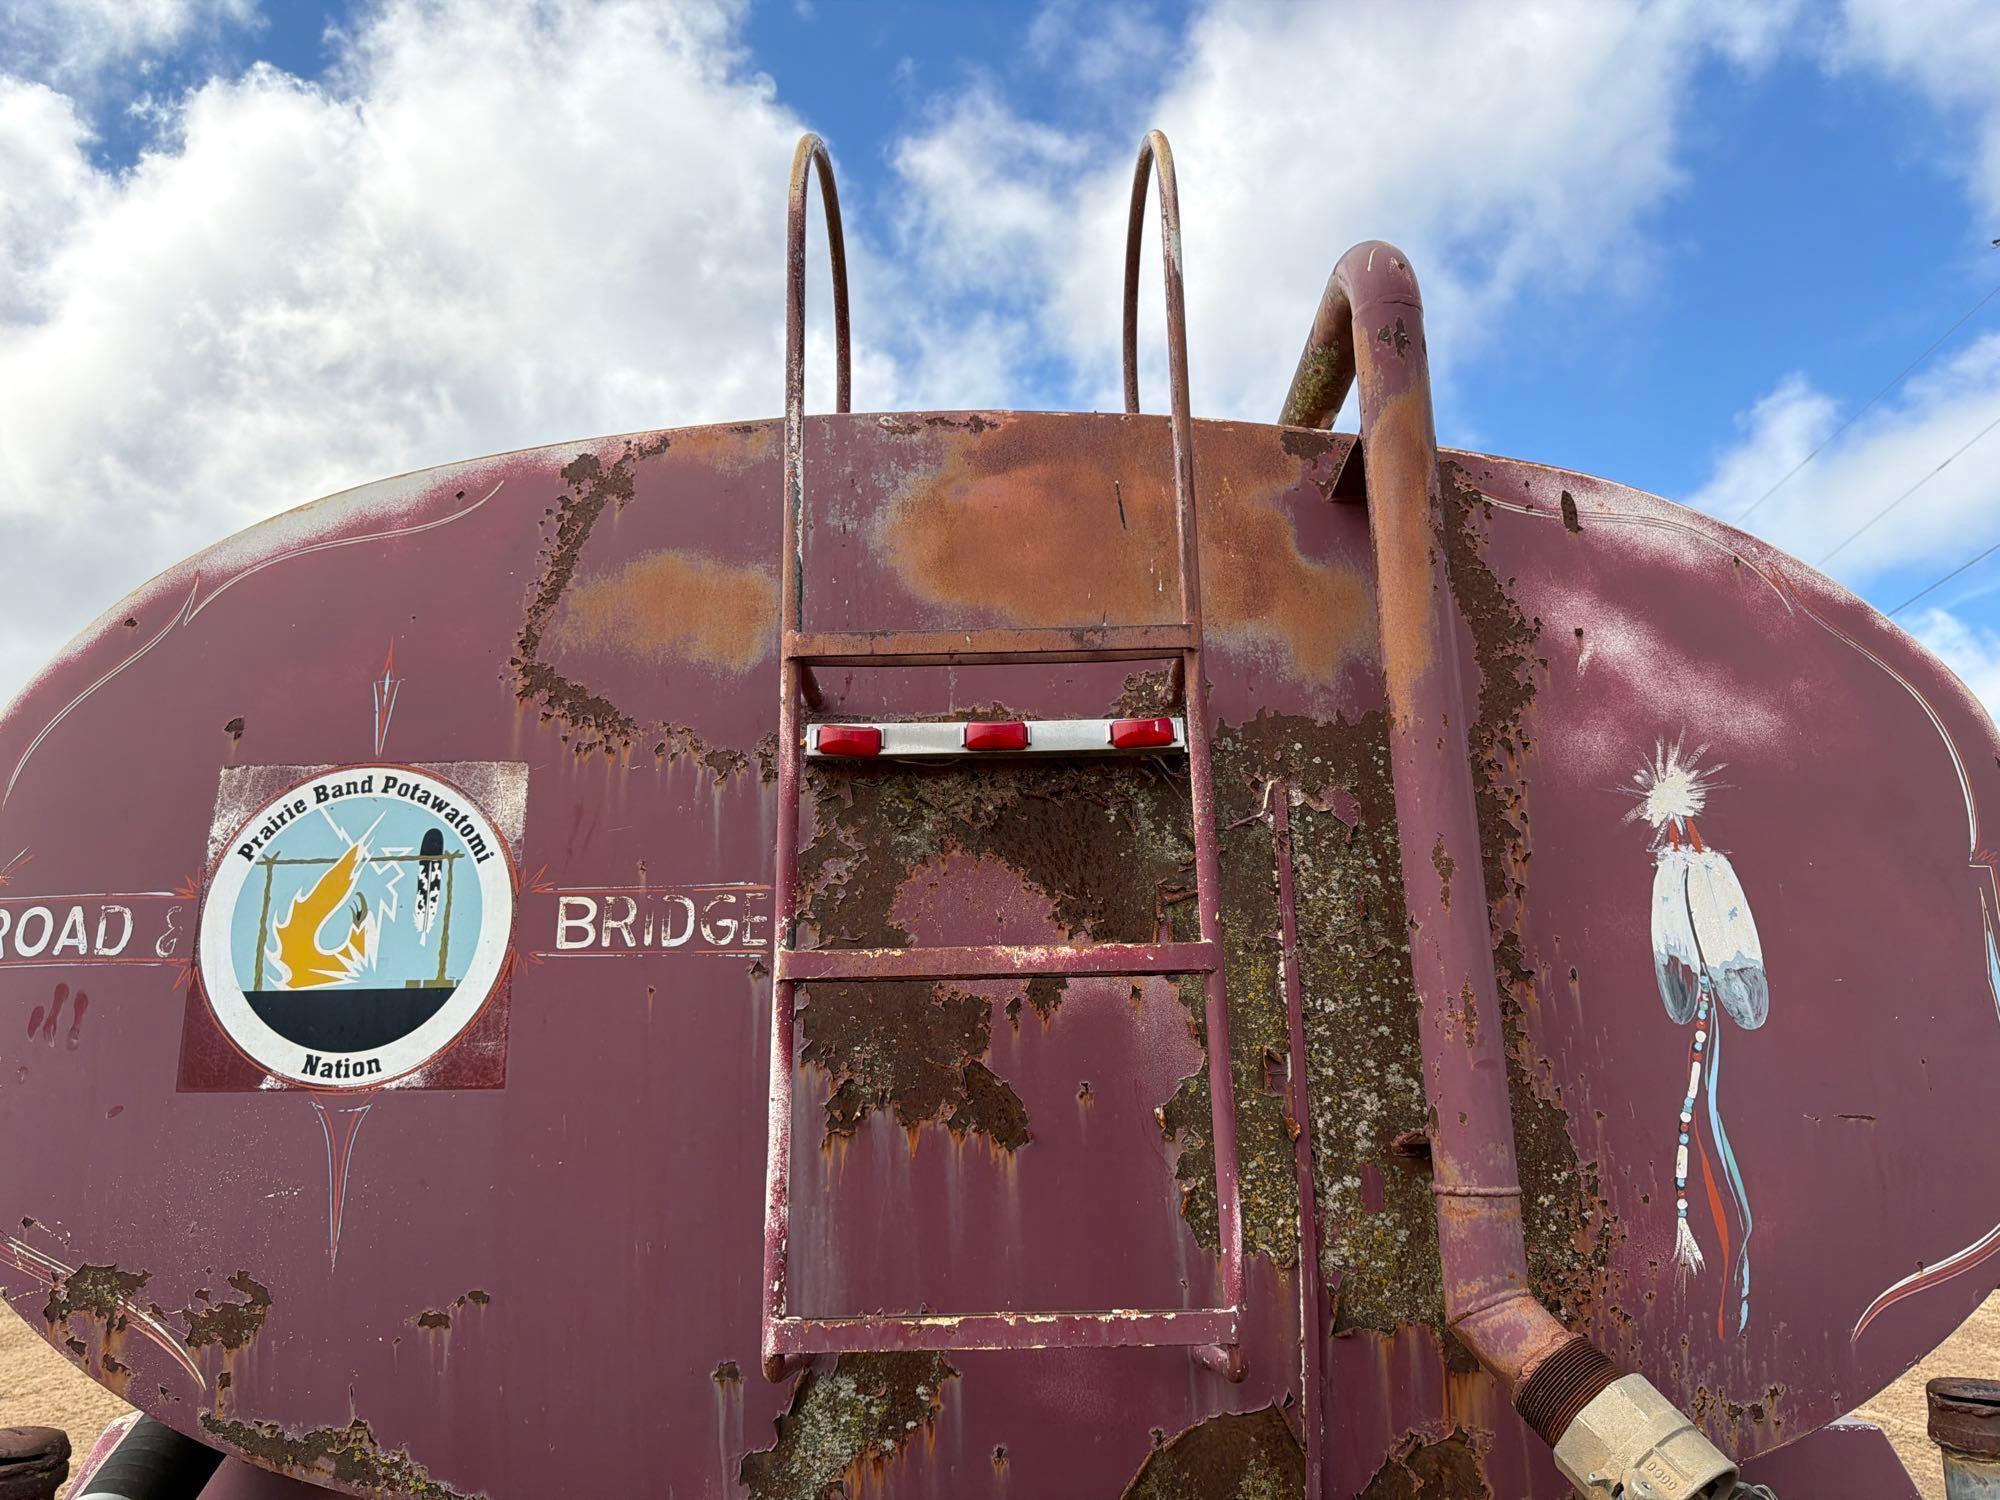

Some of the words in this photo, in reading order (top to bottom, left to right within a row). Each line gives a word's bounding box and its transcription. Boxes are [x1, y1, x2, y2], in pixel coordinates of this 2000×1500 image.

[237, 796, 308, 862] Prairie
[313, 775, 374, 805] Band
[380, 776, 495, 864] Potawatomi
[556, 892, 768, 949] BRIDGE
[300, 1053, 382, 1078] Nation
